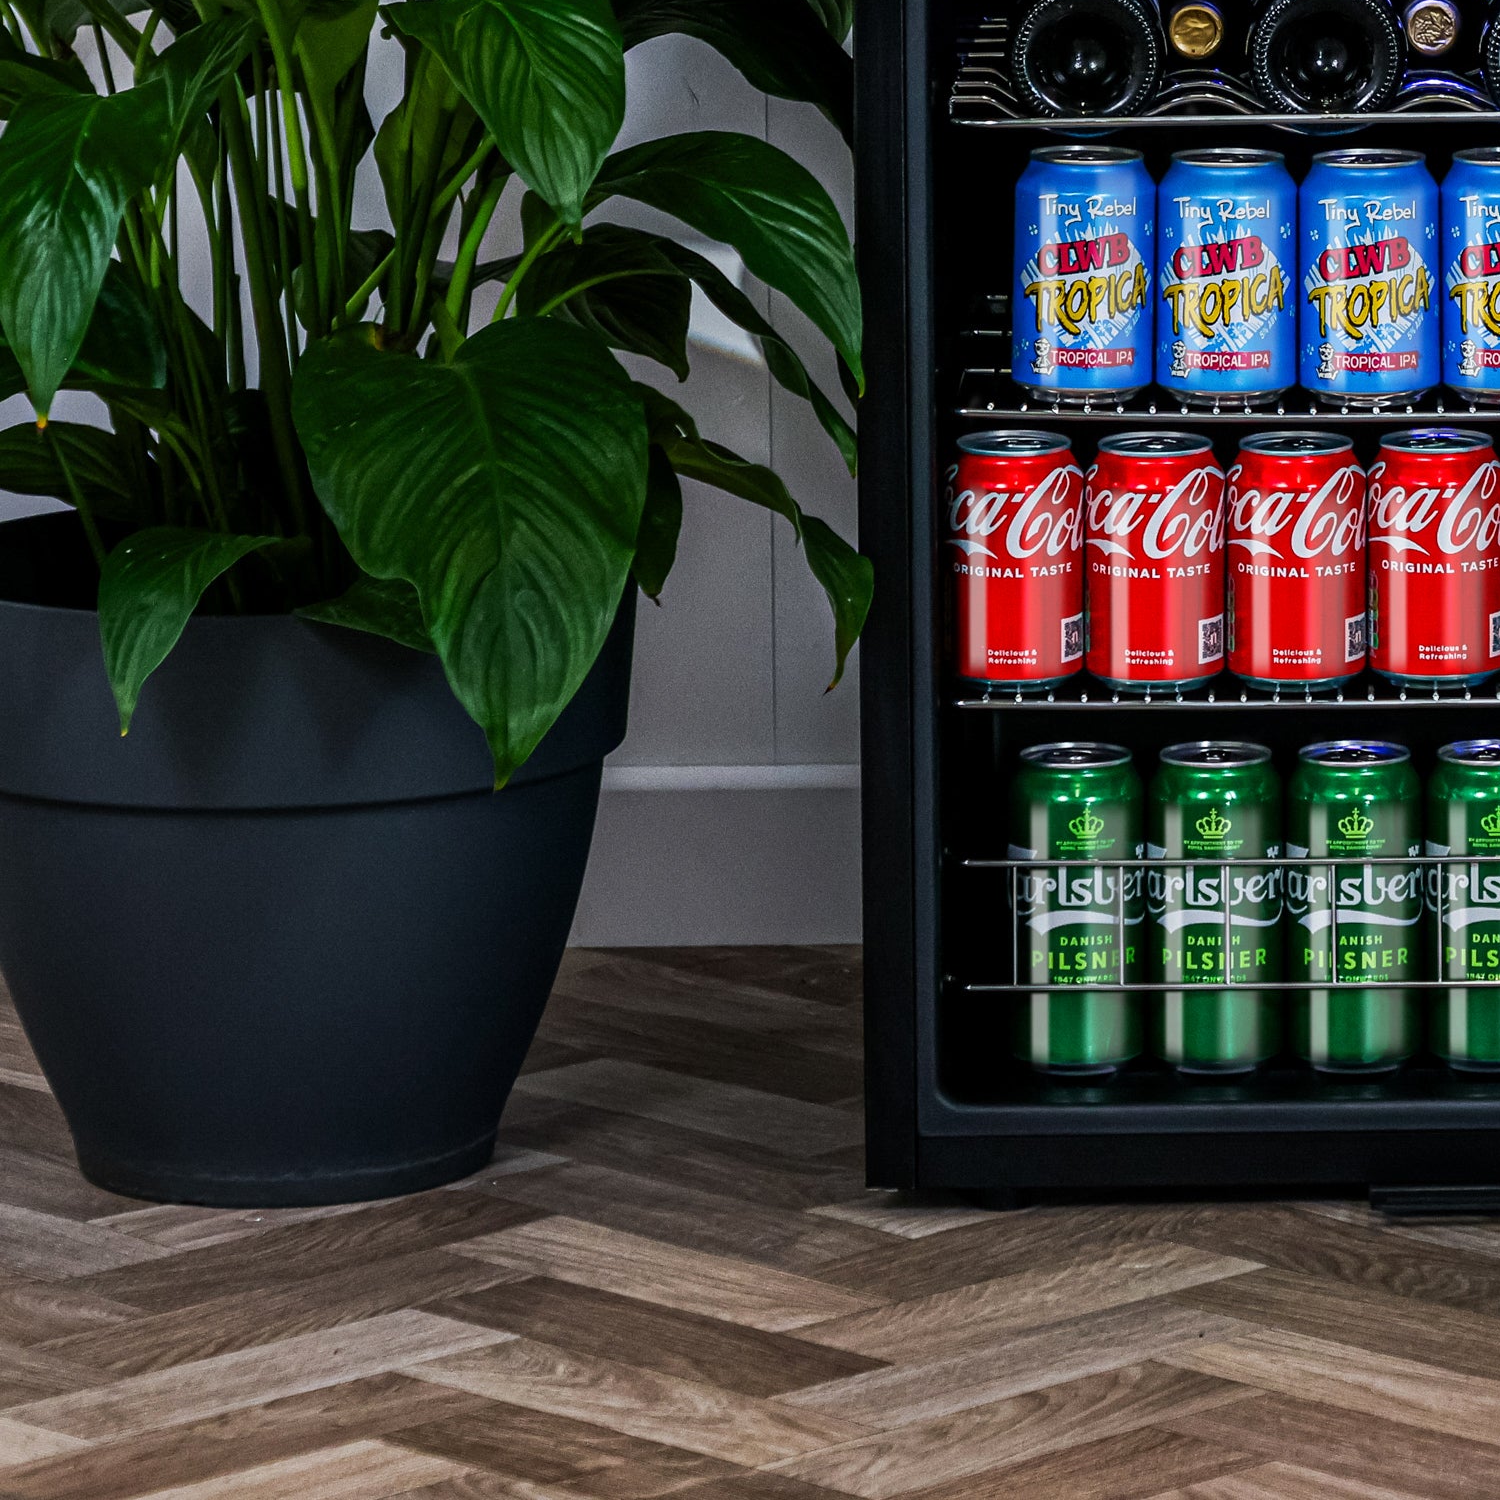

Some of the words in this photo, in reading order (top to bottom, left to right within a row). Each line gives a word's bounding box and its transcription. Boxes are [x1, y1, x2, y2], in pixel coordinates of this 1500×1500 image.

[1038, 193, 1081, 226] Tiny
[1086, 195, 1136, 219] Rebel
[1173, 196, 1213, 229] Tiny
[1217, 198, 1270, 220] Rebel
[1318, 198, 1361, 232] Tiny
[1365, 200, 1416, 220] Rebel
[1037, 232, 1131, 277] CLWB
[1173, 235, 1264, 280] CLWB
[1318, 237, 1411, 282] CLWB
[1024, 263, 1147, 335] TROPICA
[1164, 265, 1285, 337] TROPICA
[1308, 266, 1430, 339] TROPICA
[1050, 349, 1112, 365] TROPICAL
[1116, 350, 1133, 363] IPA
[1187, 352, 1247, 367] TROPICAL
[1251, 353, 1270, 366] IPA
[1335, 354, 1395, 369] TROPICAL
[1400, 355, 1417, 367] IPA
[953, 563, 1024, 578] ORIGINAL
[1030, 562, 1072, 577] TASTE
[1092, 563, 1160, 579] ORIGINAL
[1167, 563, 1211, 577] TASTE
[1238, 562, 1310, 578] ORIGINAL
[1315, 562, 1356, 577] TASTE
[1381, 559, 1454, 574] ORIGINAL
[1461, 557, 1499, 573] TASTE
[1060, 935, 1112, 946] DANISH
